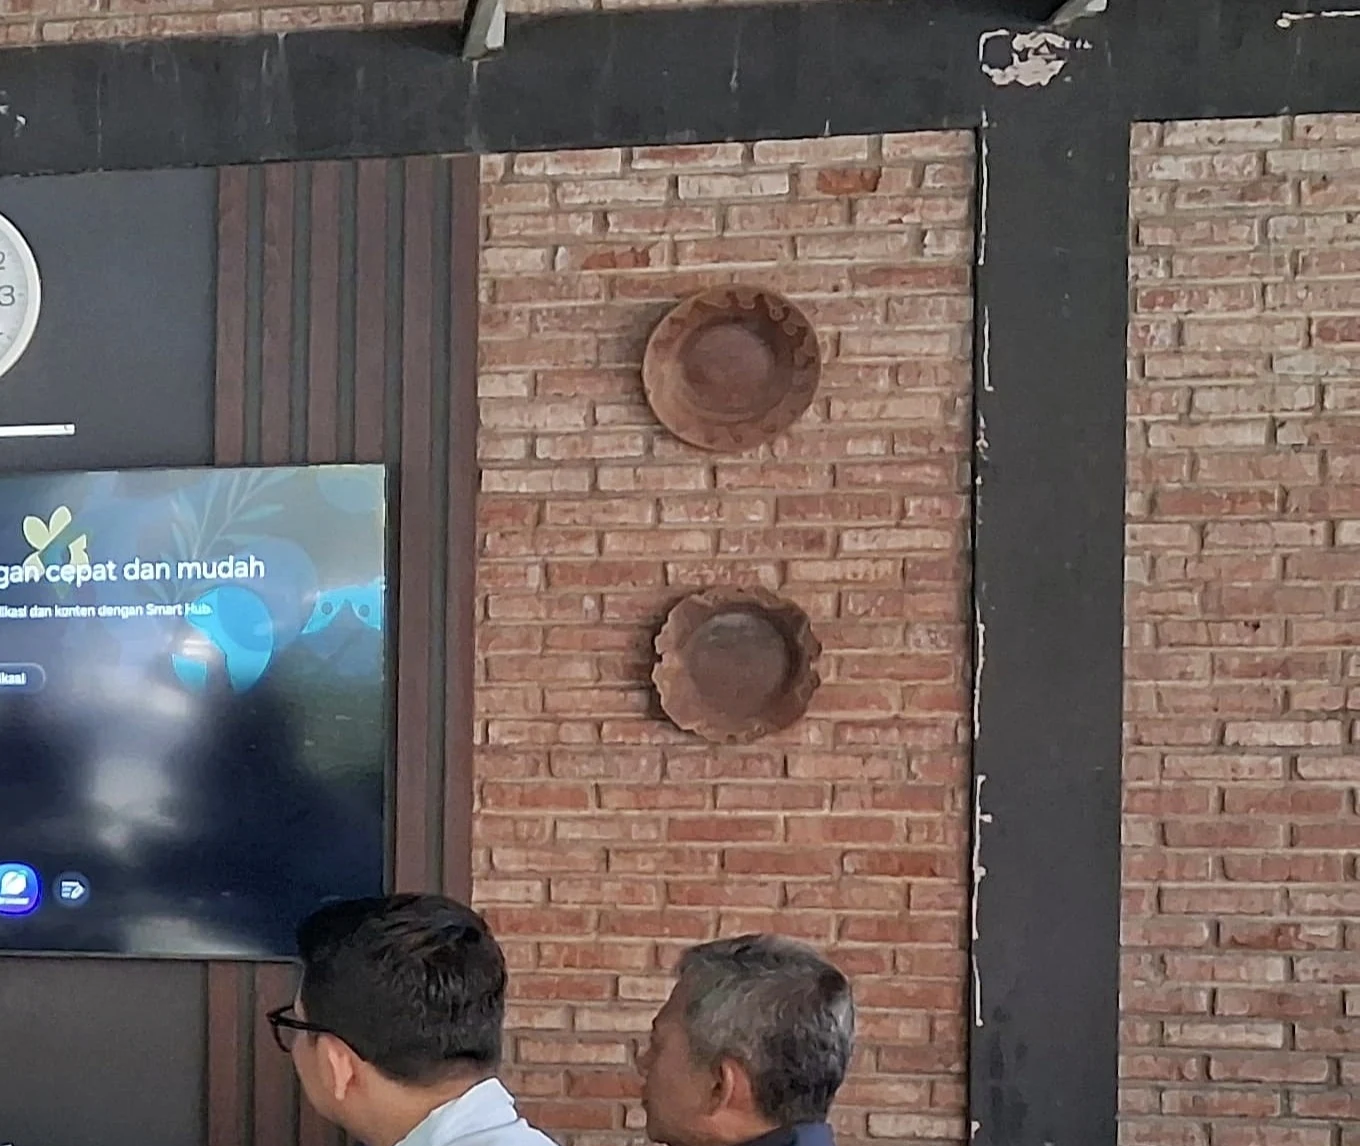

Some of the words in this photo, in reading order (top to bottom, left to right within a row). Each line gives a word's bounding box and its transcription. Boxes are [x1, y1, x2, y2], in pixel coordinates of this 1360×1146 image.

[45, 561, 118, 587] cepat
[122, 557, 171, 580] dan
[177, 556, 265, 579] mudah
[29, 604, 52, 618] dan
[54, 604, 96, 618] konten
[97, 604, 143, 619] dengan
[146, 602, 183, 616] Smart
